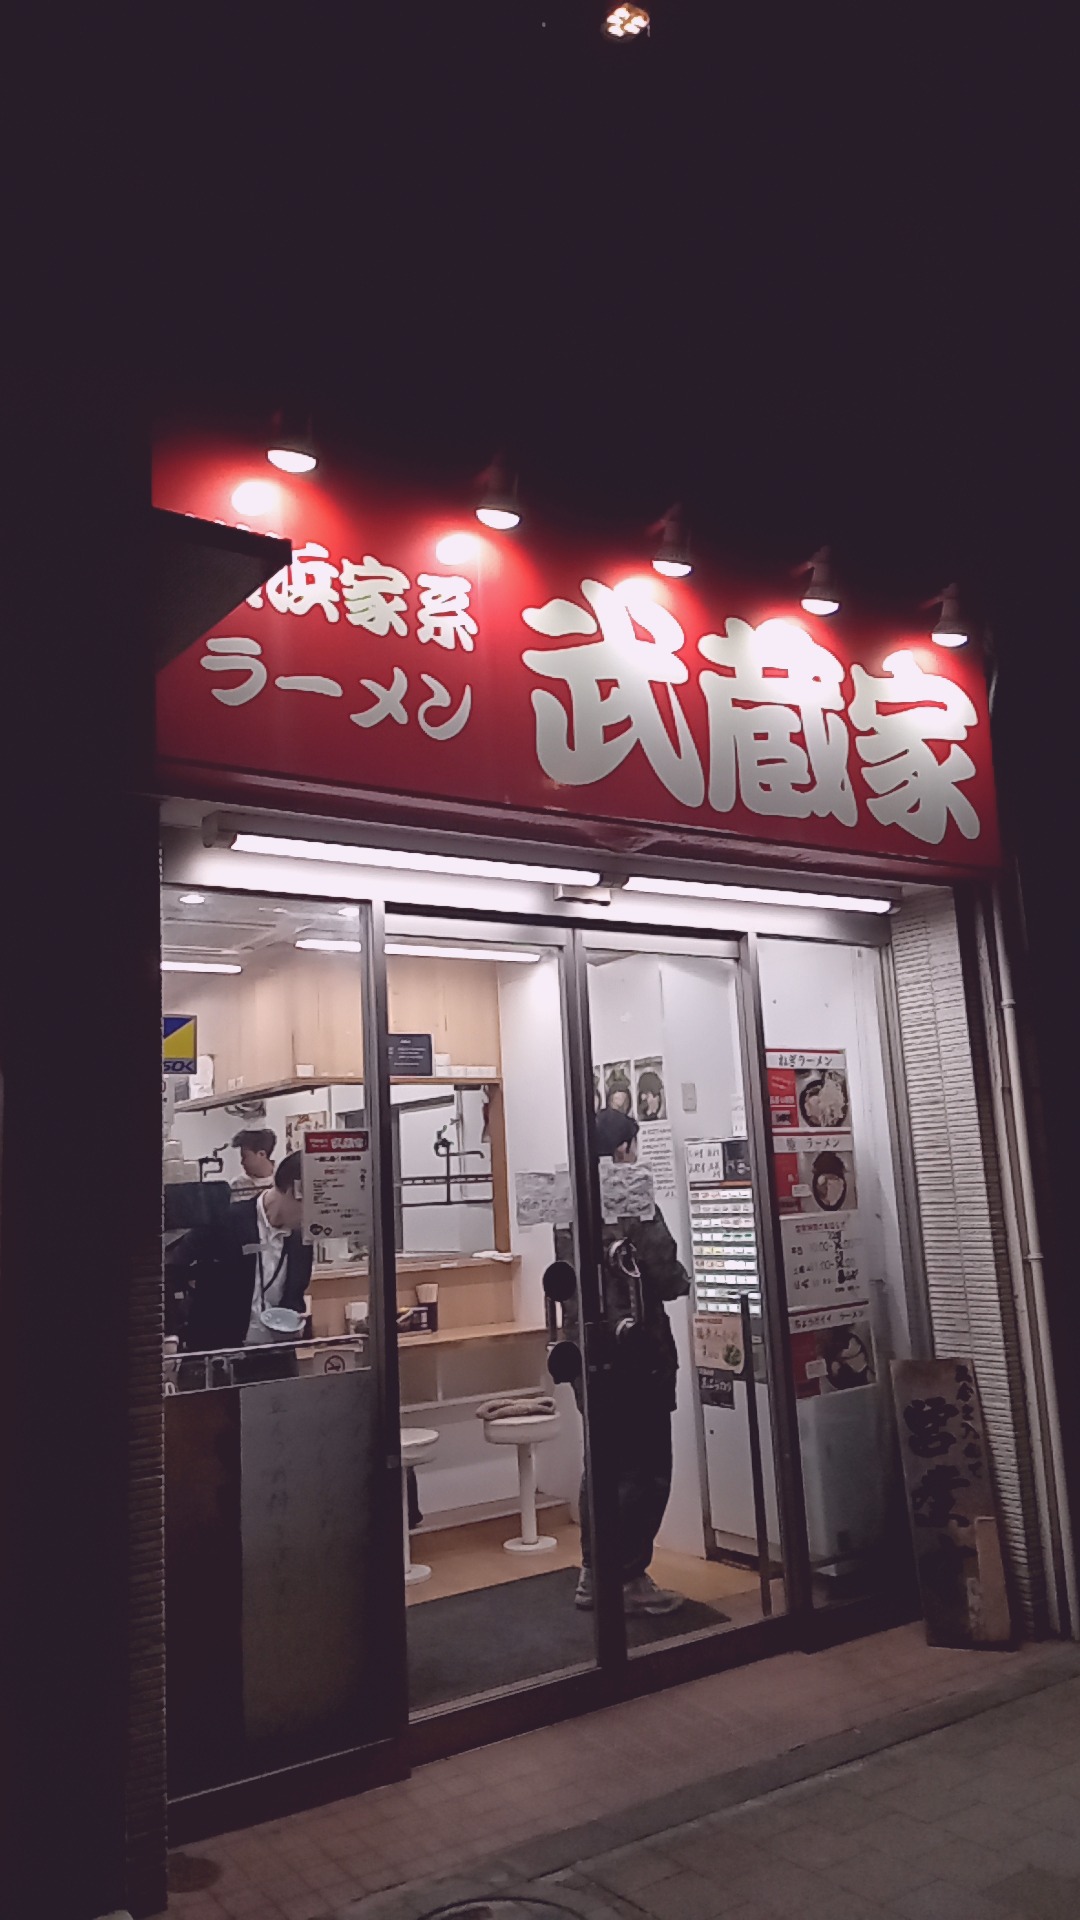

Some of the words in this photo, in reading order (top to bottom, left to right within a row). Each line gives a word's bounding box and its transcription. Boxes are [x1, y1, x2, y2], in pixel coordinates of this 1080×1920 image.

[200, 636, 473, 741] ラーメン
[521, 578, 980, 844] 武蔵家
